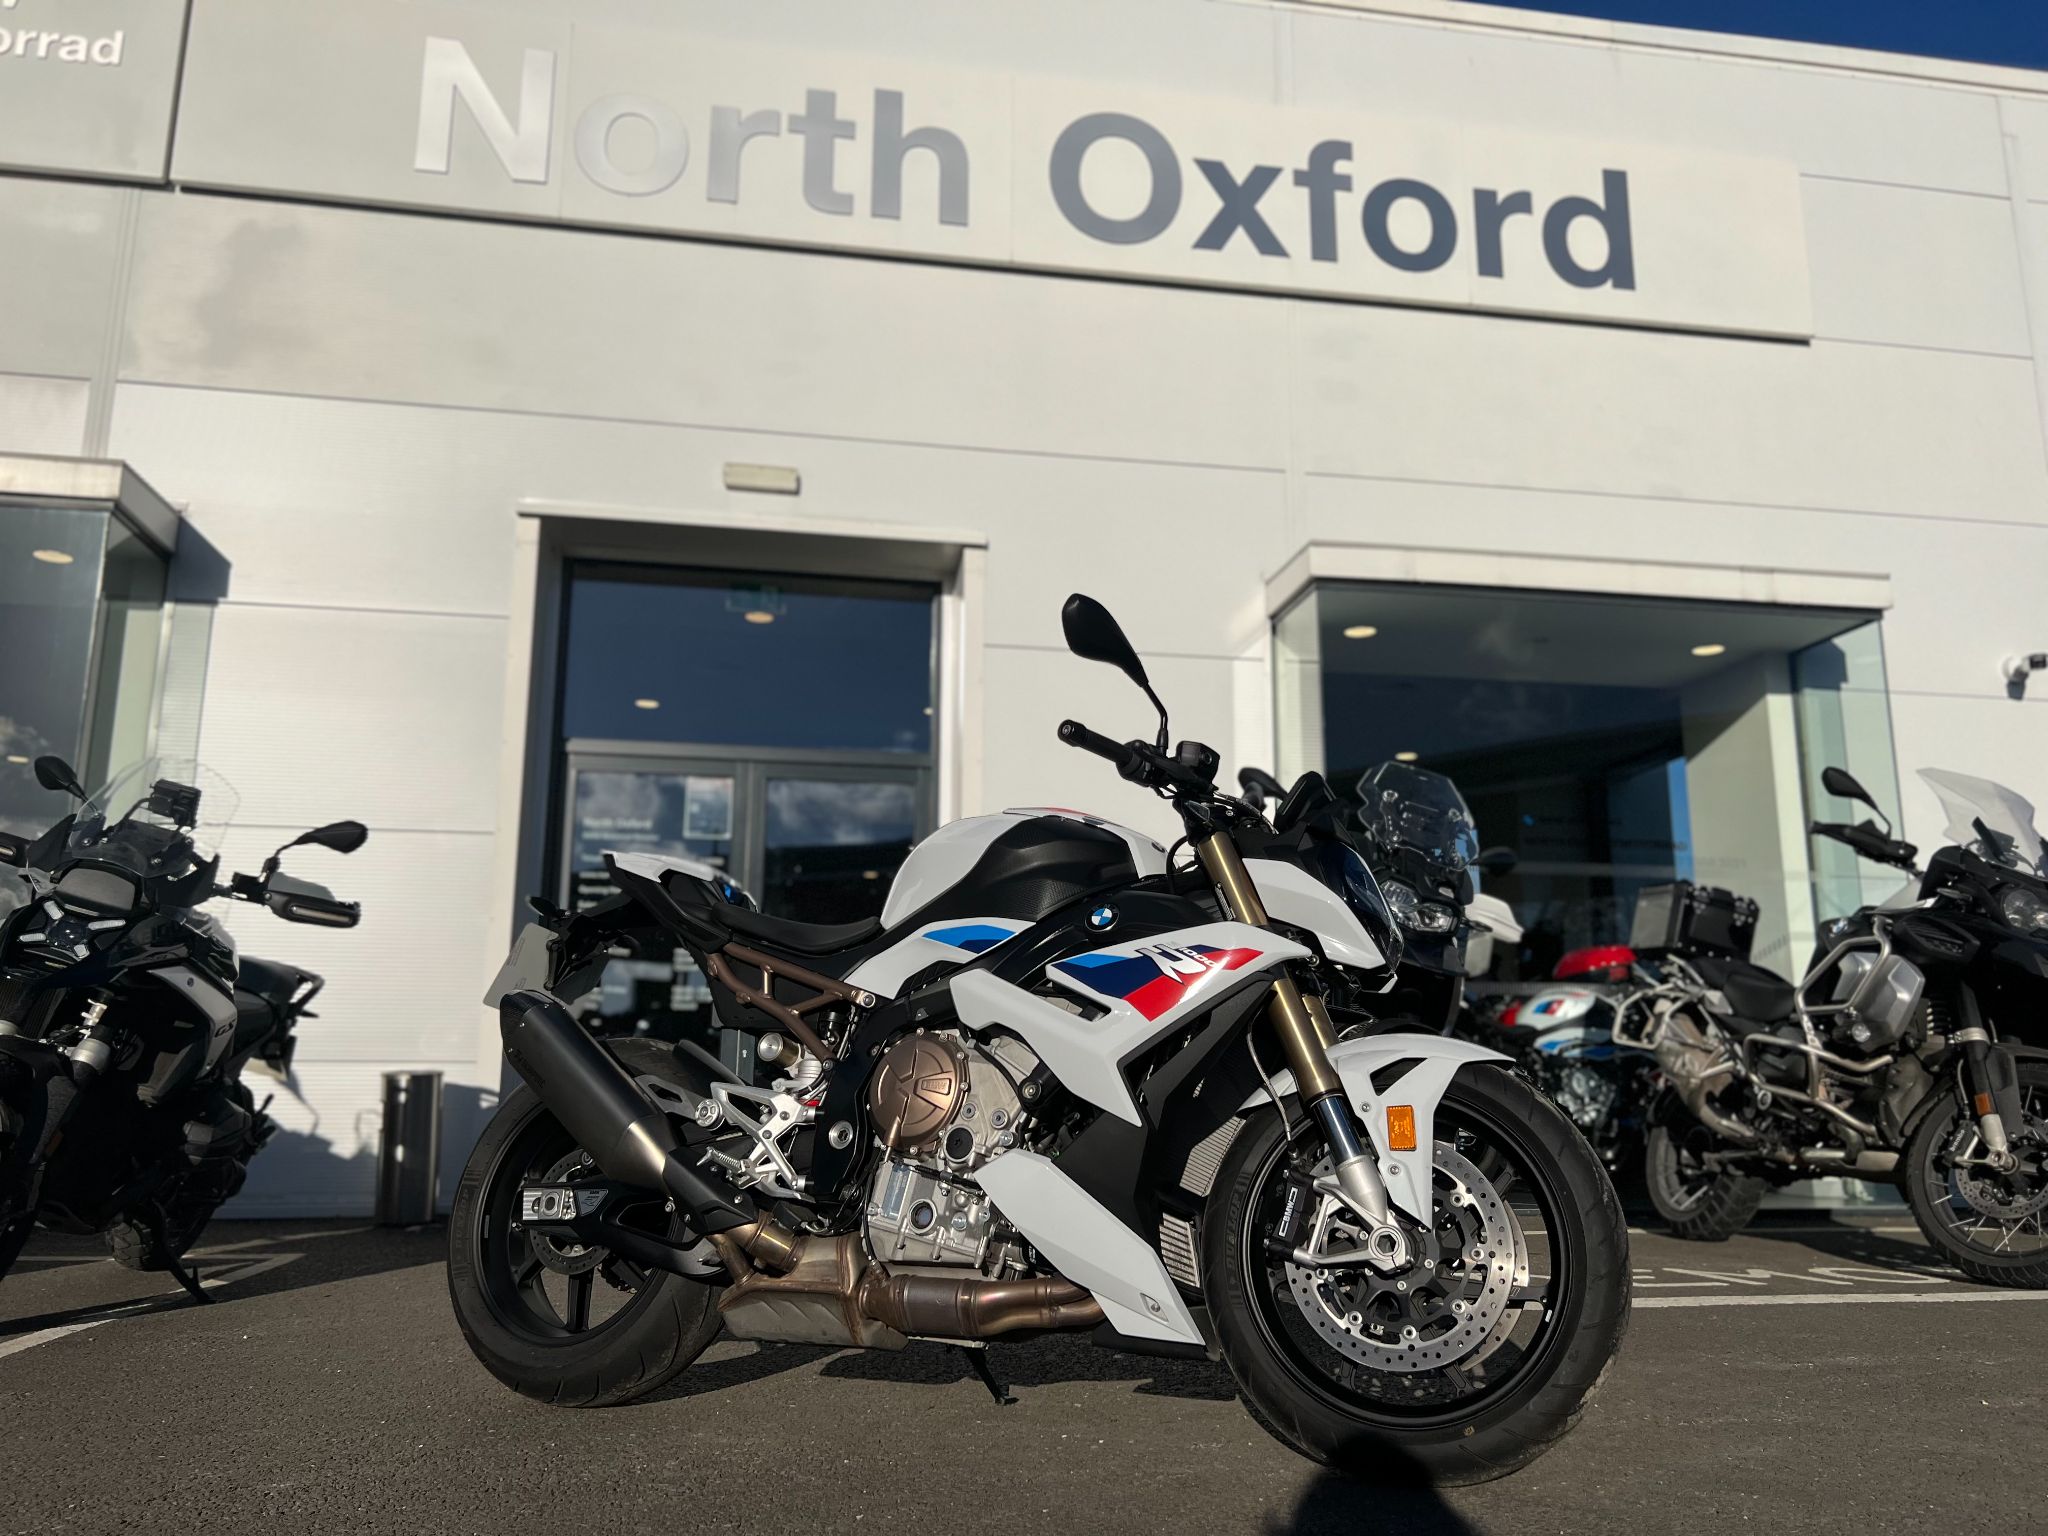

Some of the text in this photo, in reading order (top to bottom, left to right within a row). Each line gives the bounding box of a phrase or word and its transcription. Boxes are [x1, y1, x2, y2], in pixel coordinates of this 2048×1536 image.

[413, 35, 1636, 290] North Oxford
[1282, 1200, 1295, 1223] BMW
